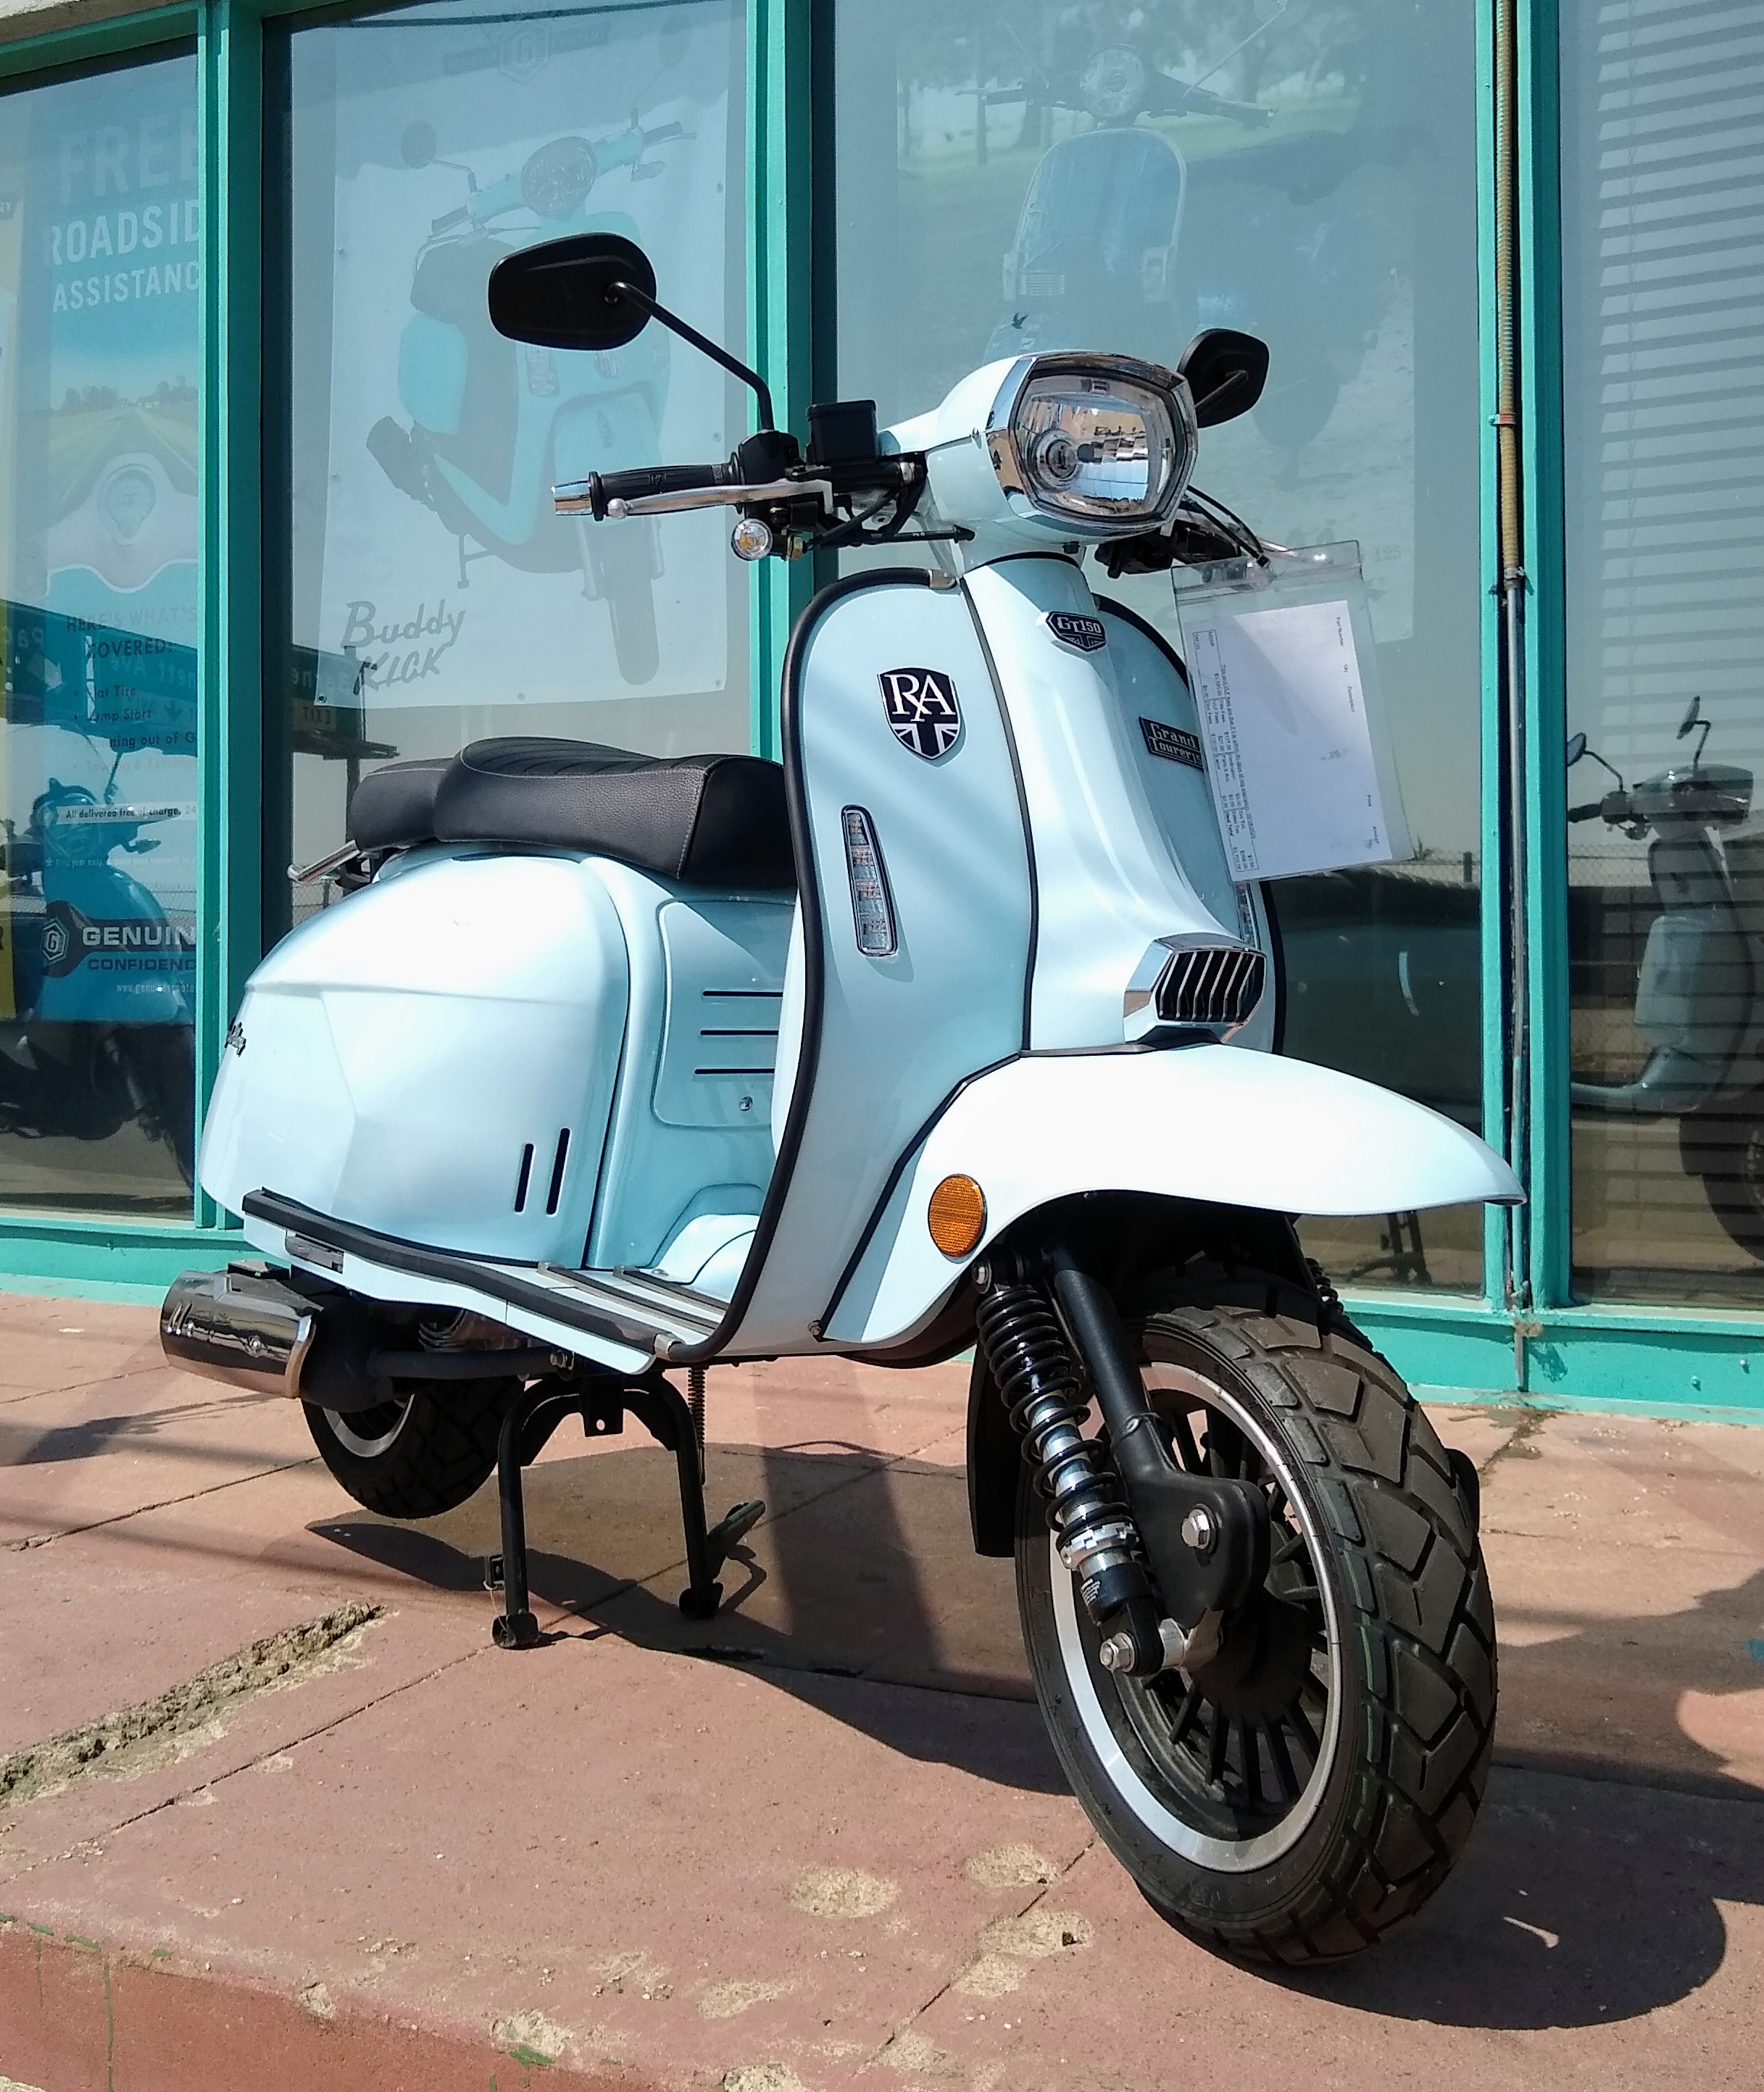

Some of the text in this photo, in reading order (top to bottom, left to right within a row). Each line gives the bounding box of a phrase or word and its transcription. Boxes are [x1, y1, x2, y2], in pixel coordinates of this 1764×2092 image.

[341, 599, 465, 648] Buddy
[1057, 616, 1102, 634] GT150
[114, 684, 137, 698] Tire
[884, 674, 957, 722] RA
[123, 708, 151, 720] Start
[141, 733, 159, 746] out
[165, 731, 179, 744] of
[185, 731, 197, 744] G
[1149, 722, 1197, 749] Grand
[1148, 735, 1191, 759] Tourer
[66, 809, 77, 820] All
[79, 807, 117, 819] delivered
[119, 807, 136, 817] free
[82, 926, 197, 946] GENUIN
[87, 957, 197, 972] CONFIDENC
